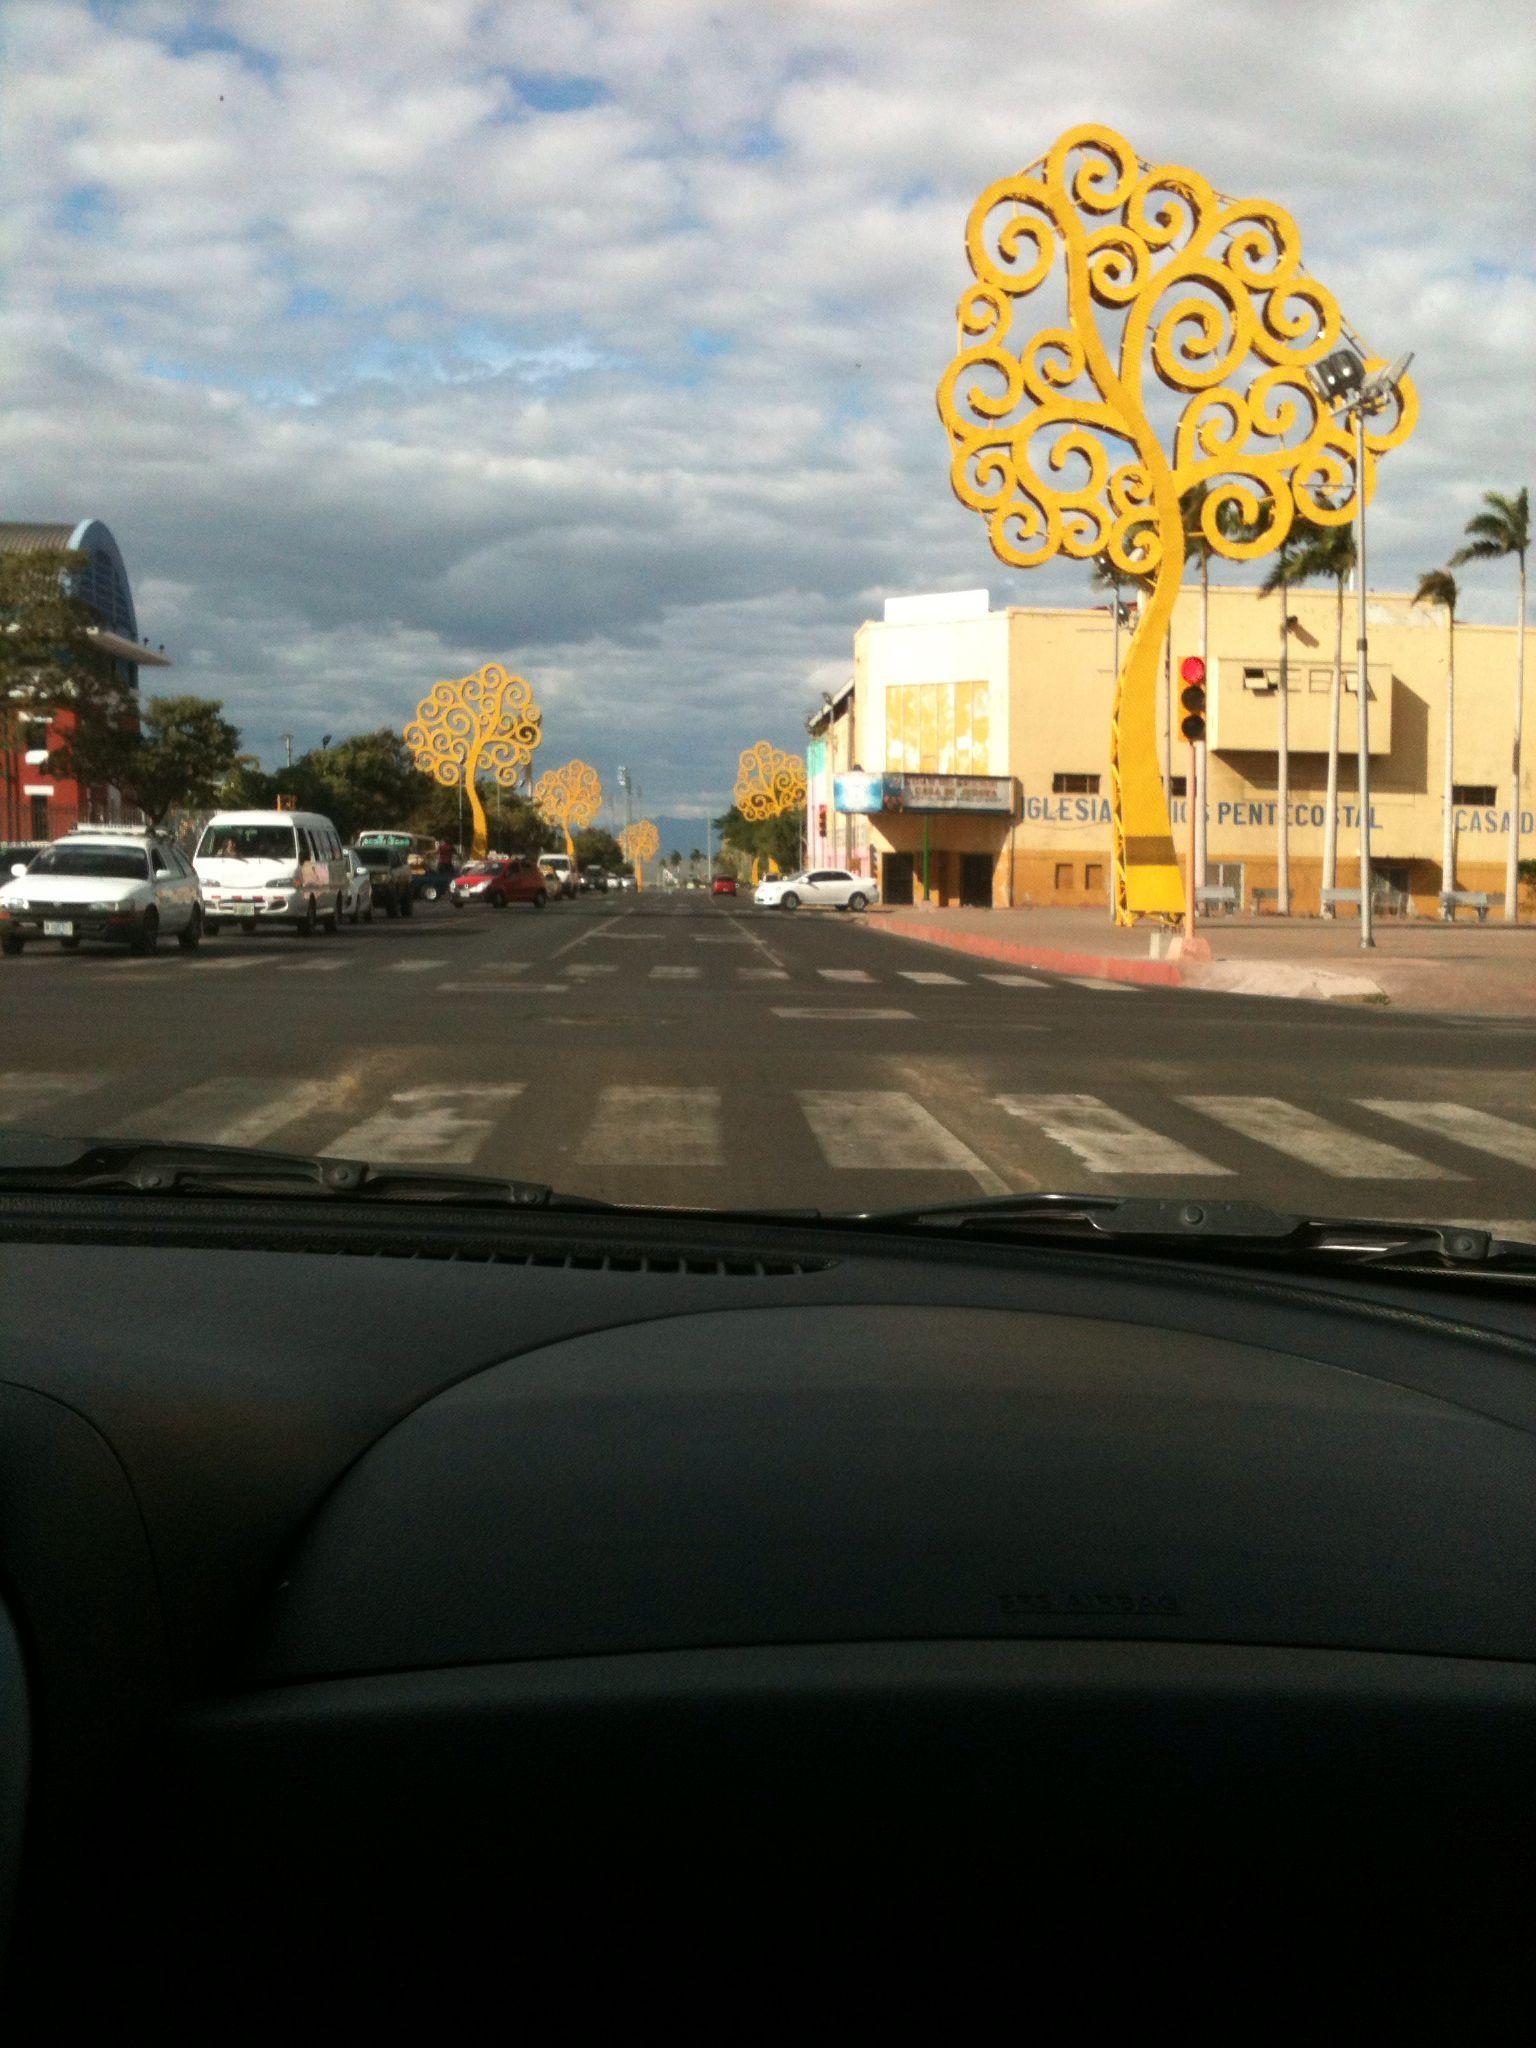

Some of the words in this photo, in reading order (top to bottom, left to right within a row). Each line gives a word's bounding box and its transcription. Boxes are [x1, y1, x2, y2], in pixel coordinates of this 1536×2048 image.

[1020, 796, 1112, 823] IGLESIA
[1218, 802, 1383, 829] PENTECOTL
[1455, 809, 1510, 833] CASA
